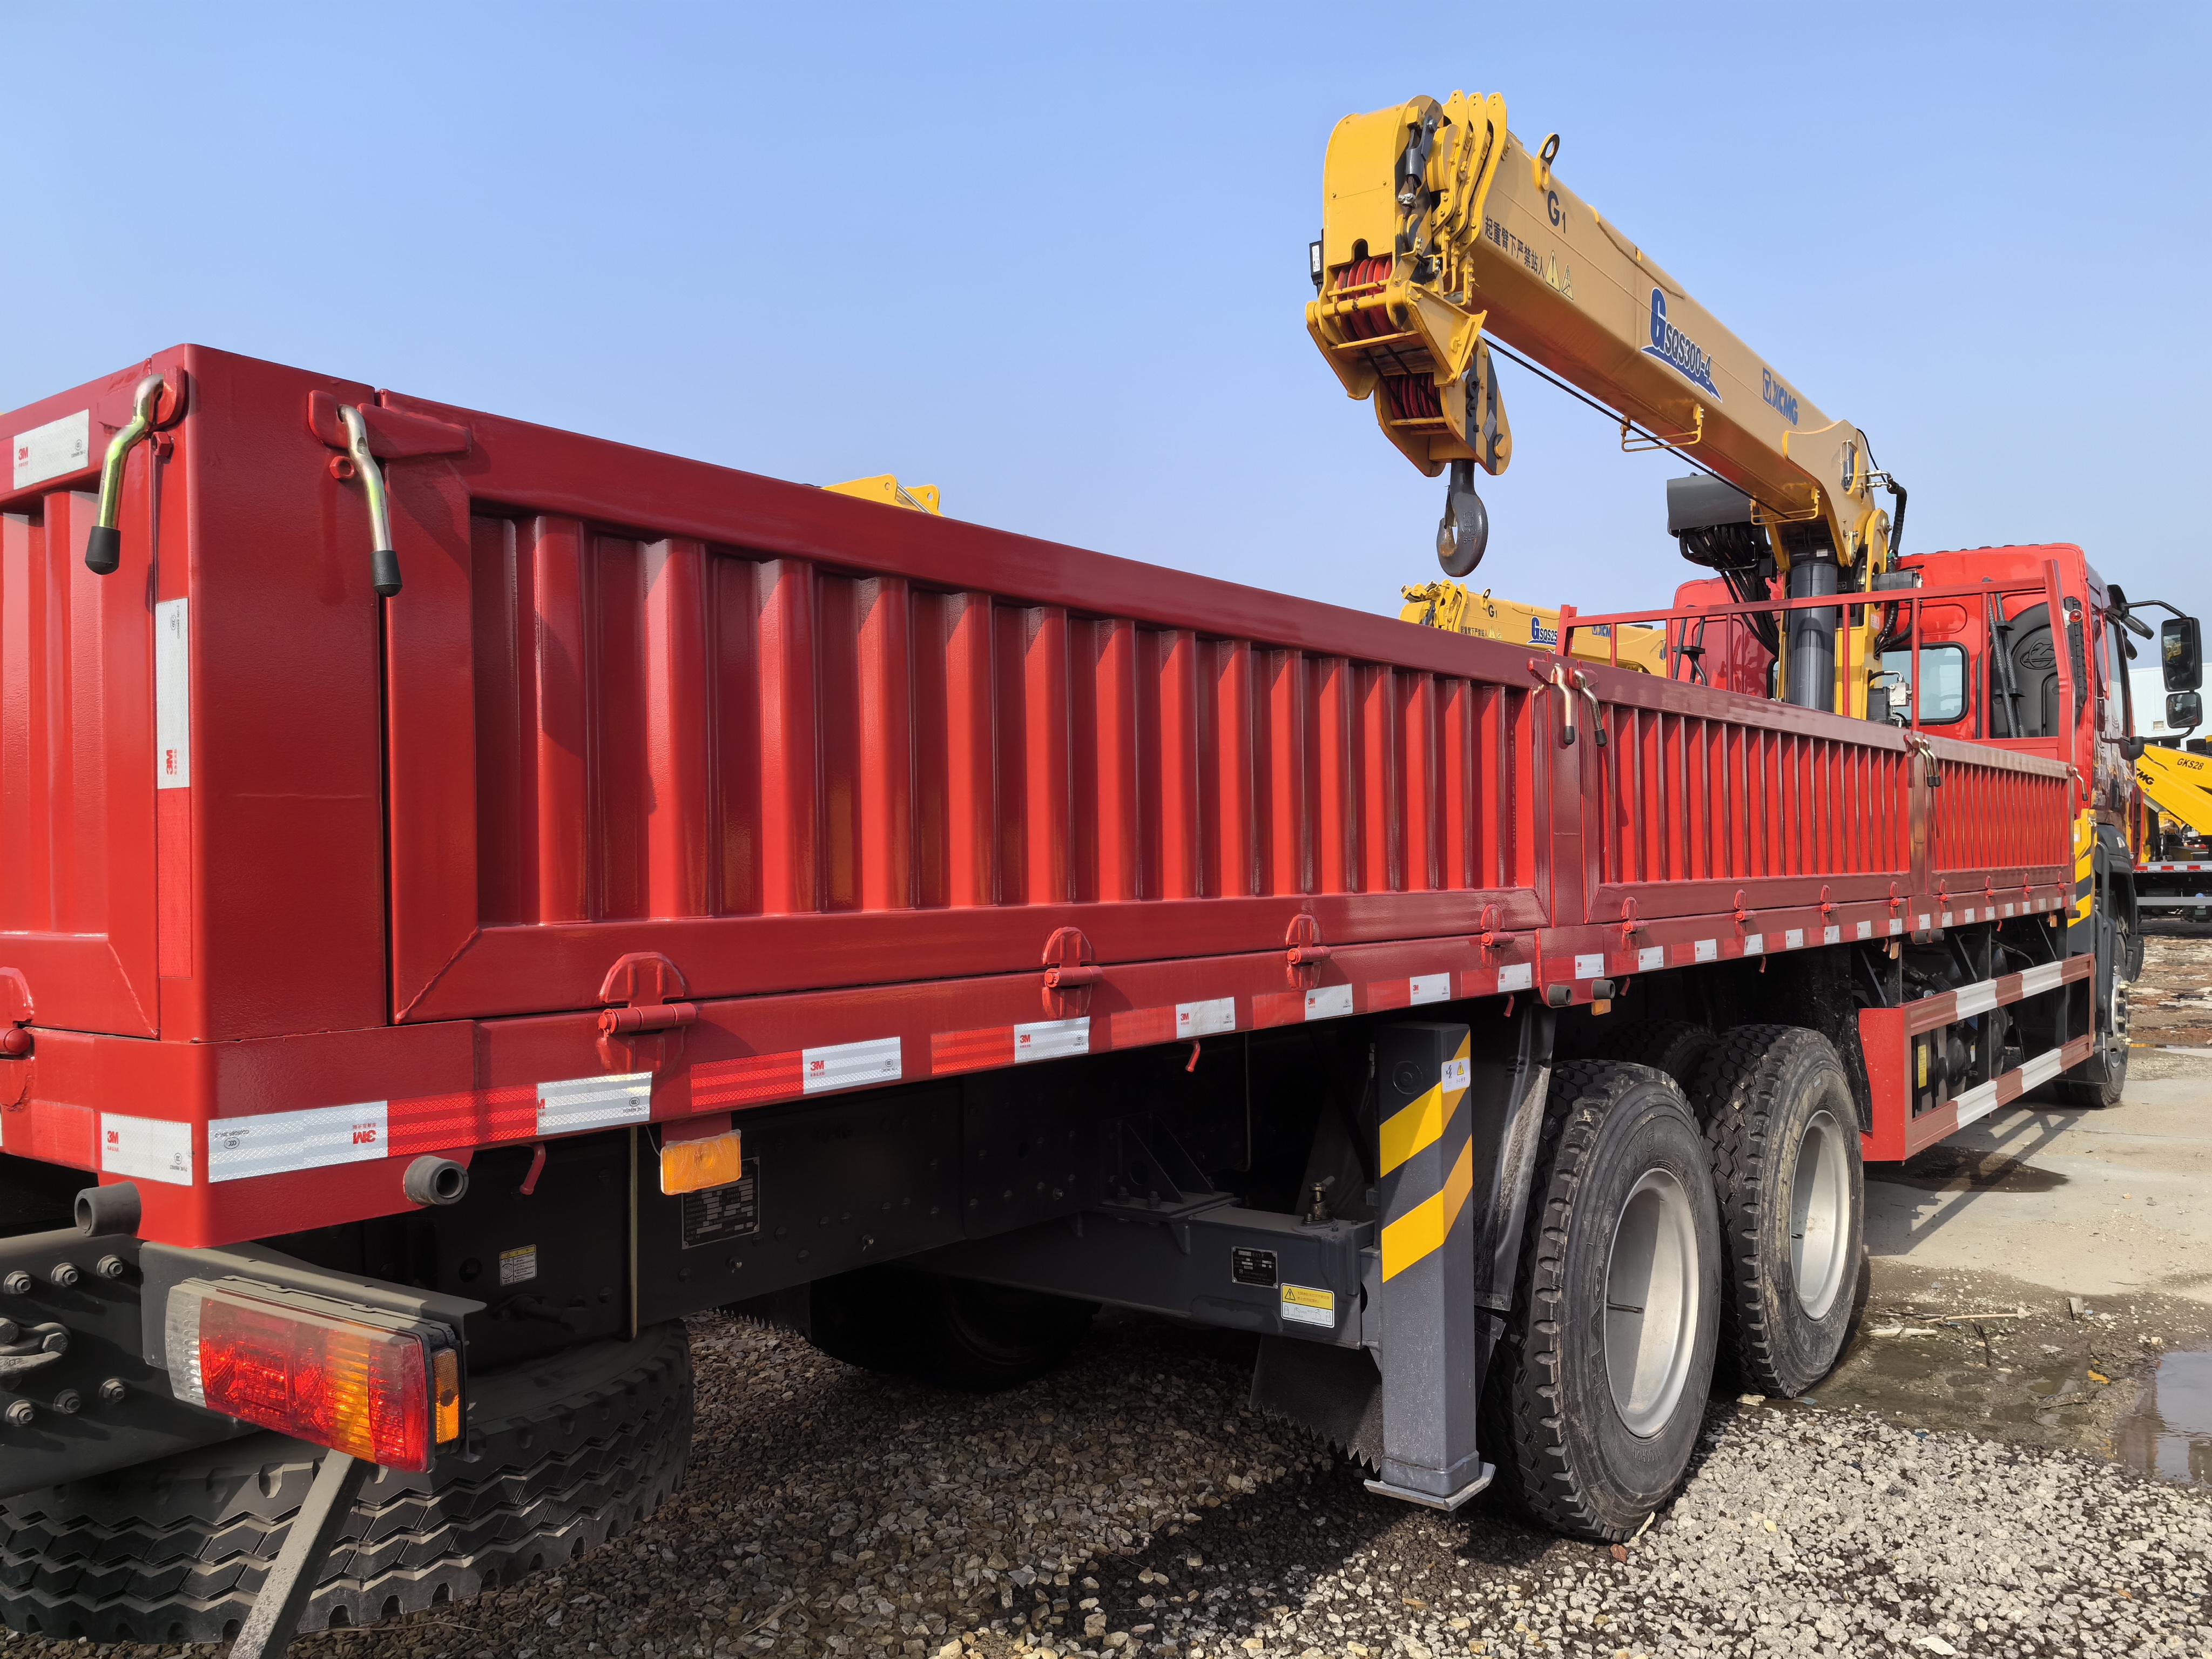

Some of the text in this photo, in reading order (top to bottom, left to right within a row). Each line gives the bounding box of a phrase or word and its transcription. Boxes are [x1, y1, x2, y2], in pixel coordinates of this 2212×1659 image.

[1485, 214, 1545, 279] 起重臂下严禁站人
[1771, 379, 1798, 426] XCMG
[18, 446, 29, 461] 3M
[166, 749, 173, 775] 3M
[2177, 758, 2204, 770] GKS28
[1181, 1013, 1189, 1021] 3M
[1020, 1034, 1031, 1043] 3M
[810, 1060, 824, 1071] 3M
[107, 1130, 119, 1144] 3M
[353, 1130, 376, 1144] 3M
